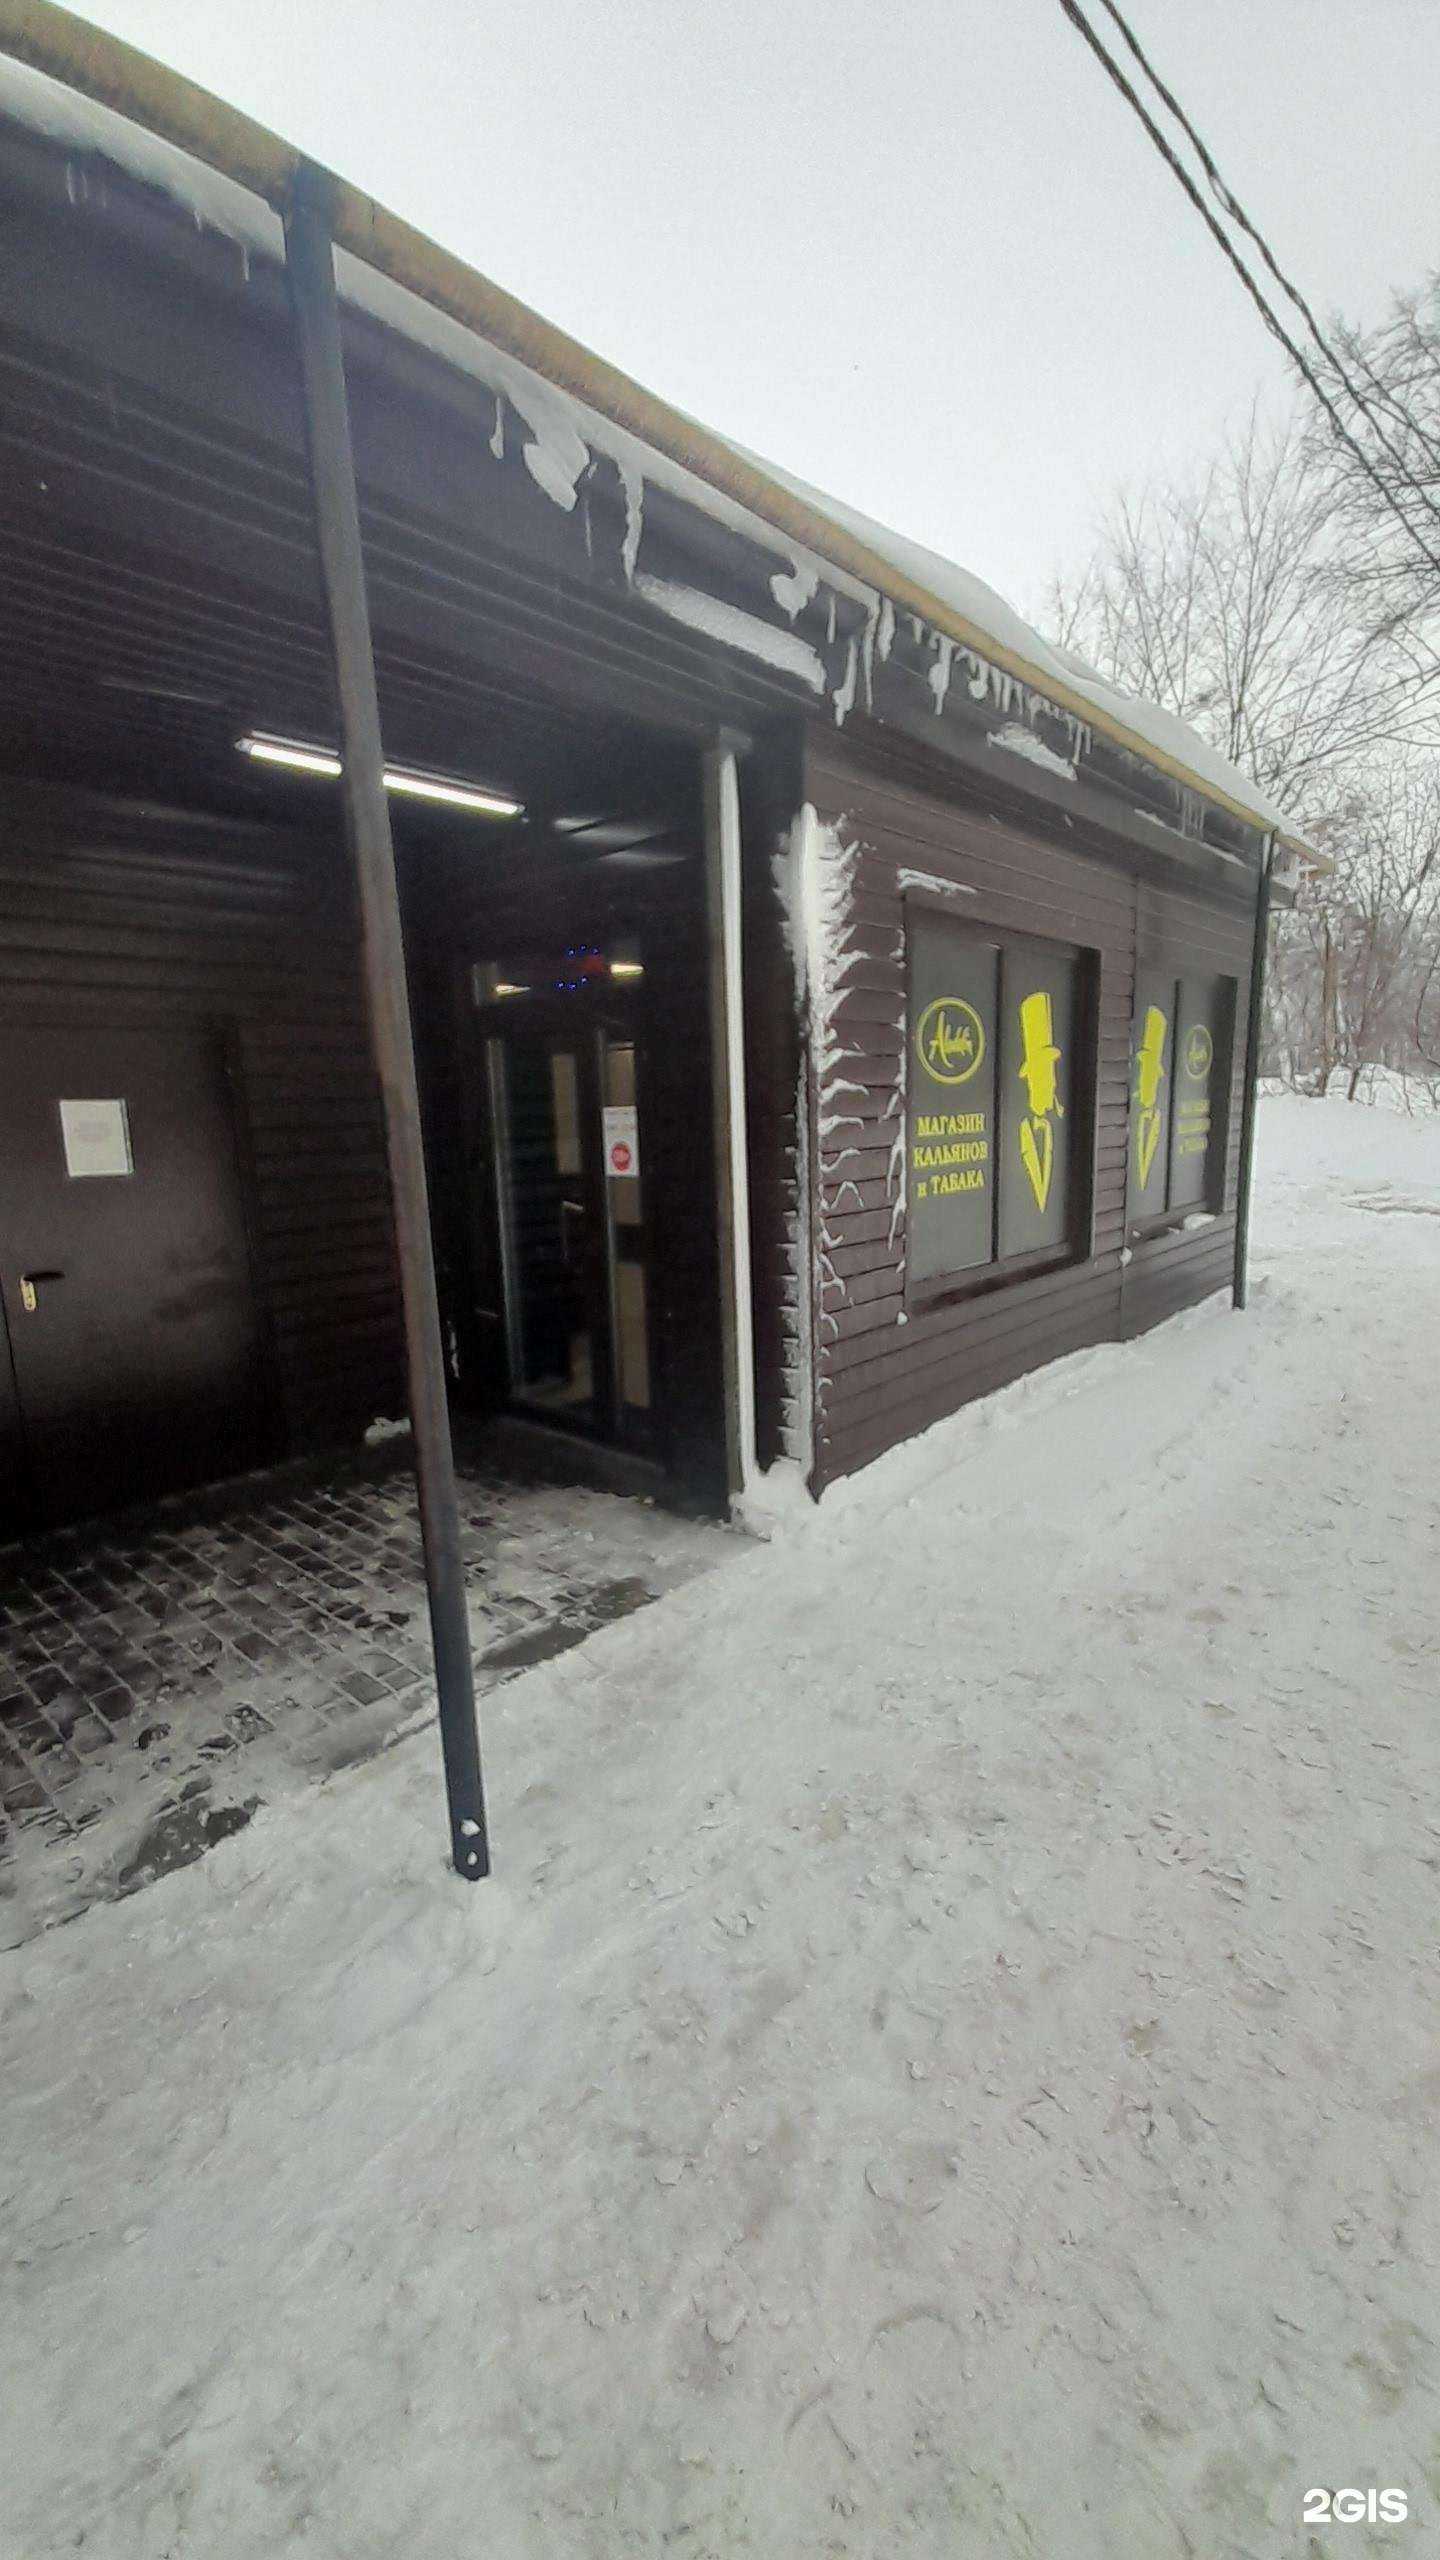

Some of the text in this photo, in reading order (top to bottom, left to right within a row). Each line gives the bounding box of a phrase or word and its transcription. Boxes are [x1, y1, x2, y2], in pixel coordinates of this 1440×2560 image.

[918, 1113, 984, 1137] МАГАЗИН
[913, 1141, 989, 1170] КАЛЬЯНОВ
[931, 1169, 985, 1195] ТАБАКА
